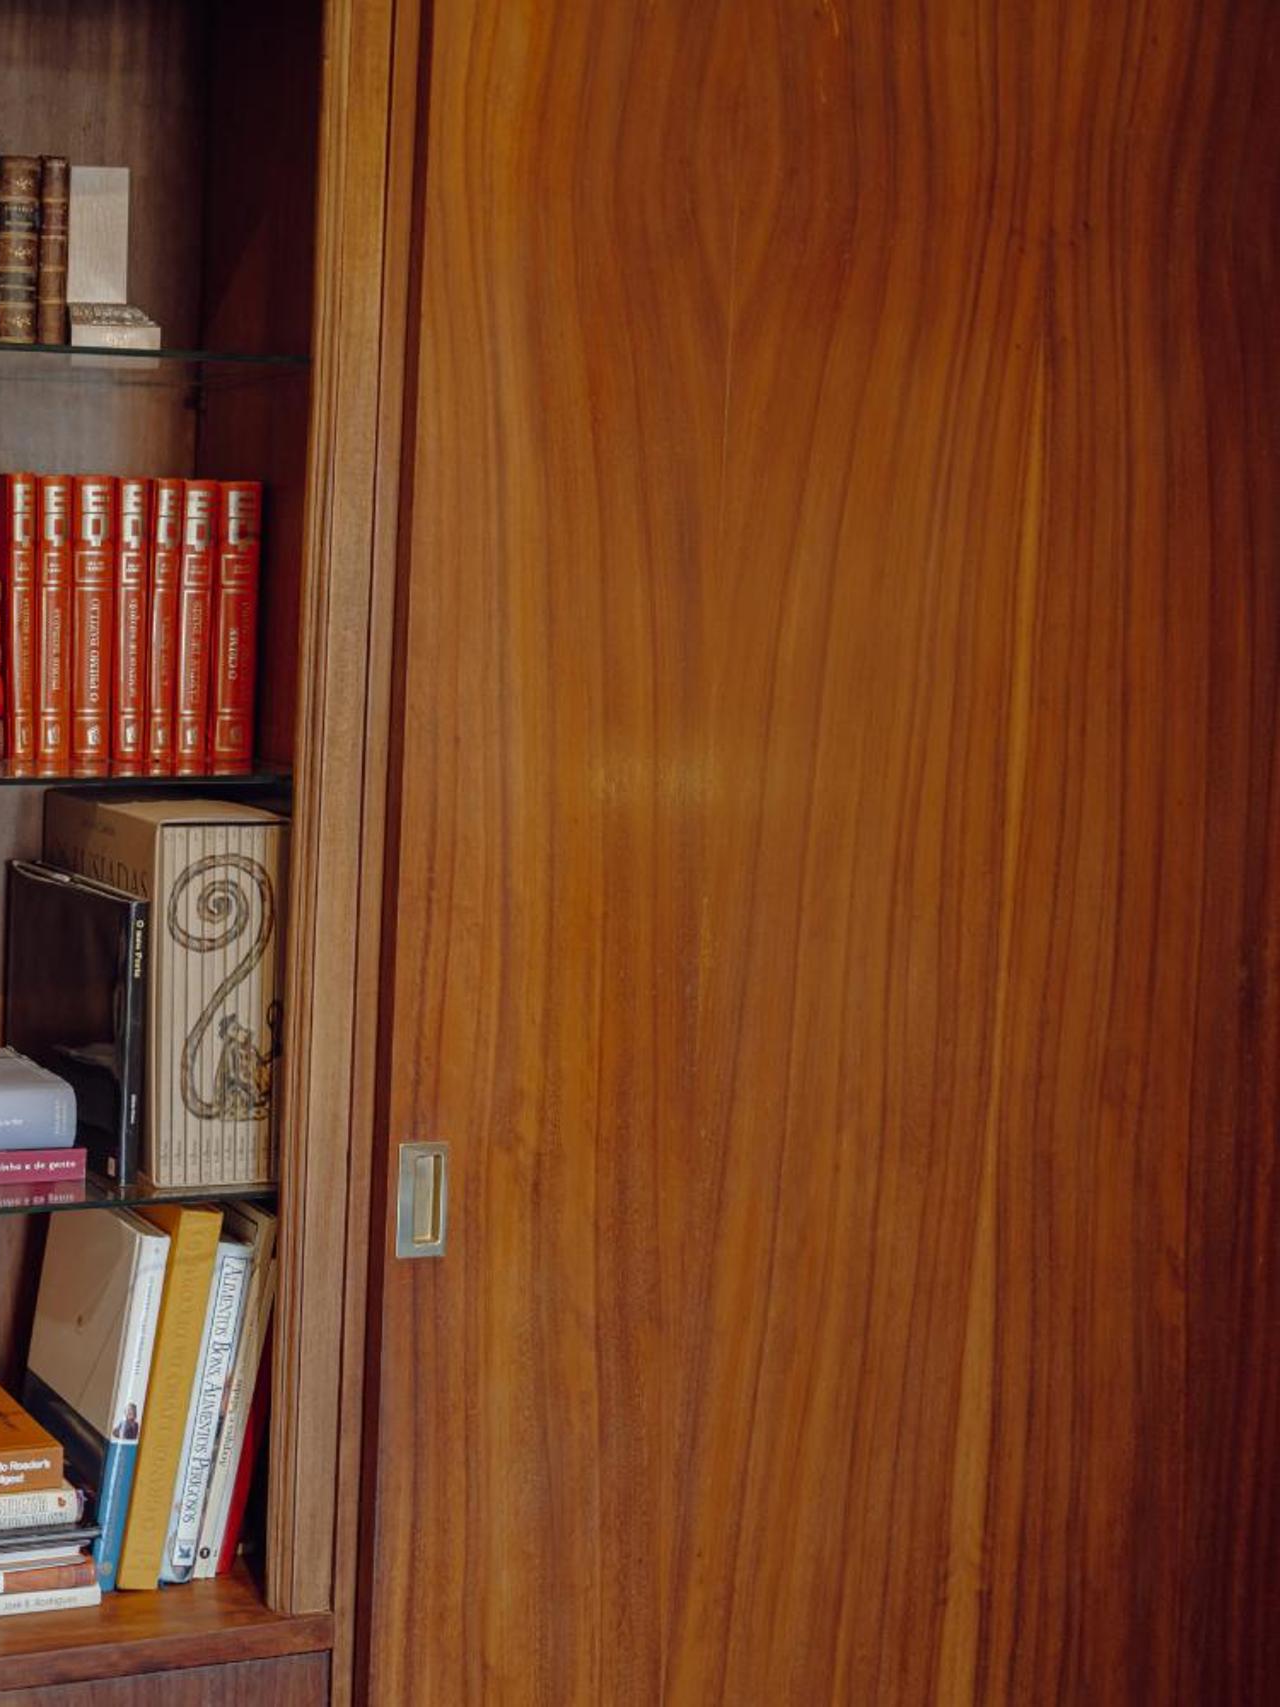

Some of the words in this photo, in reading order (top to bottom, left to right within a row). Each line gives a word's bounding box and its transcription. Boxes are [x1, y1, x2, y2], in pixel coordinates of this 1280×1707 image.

[88, 649, 101, 689] PRIMO
[88, 691, 101, 702] O
[24, 1163, 32, 1171] e
[33, 1160, 46, 1171] de
[49, 1159, 76, 1171] gente
[9, 1459, 51, 1472] Reader's
[183, 1455, 210, 1523] PERIGOSOS
